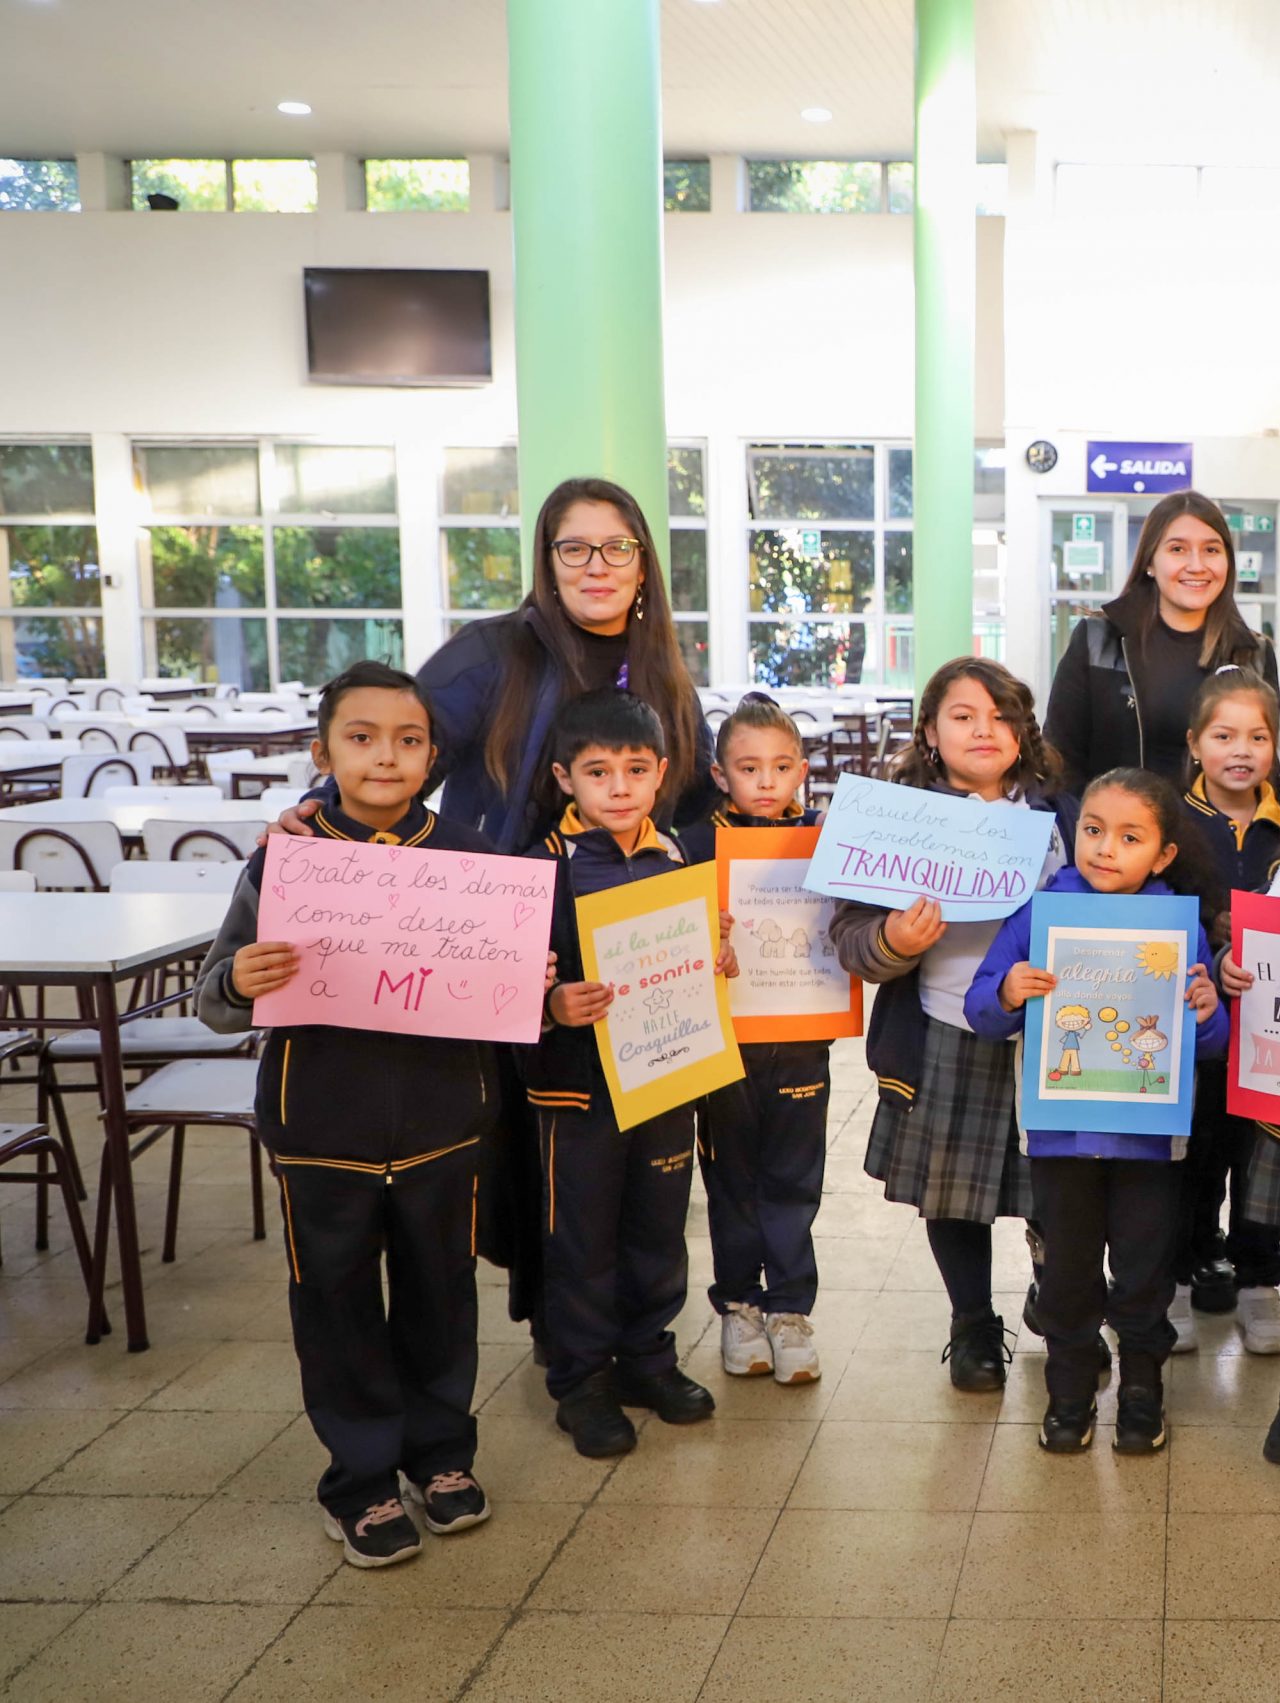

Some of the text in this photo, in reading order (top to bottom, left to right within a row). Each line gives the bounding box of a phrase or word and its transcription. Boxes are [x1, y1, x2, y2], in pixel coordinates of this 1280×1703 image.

[1120, 459, 1187, 476] SALIDA
[838, 782, 1014, 840] Resuelve los
[852, 828, 1034, 867] problemas con
[279, 838, 548, 899] Trato a los demás
[287, 904, 487, 933] como deseo
[306, 936, 523, 970] que me traten
[603, 917, 699, 960] si la vida
[639, 949, 668, 969] no
[1257, 962, 1276, 982] EL
[310, 979, 338, 998] a
[639, 959, 705, 989] sonríe
[1075, 991, 1104, 1000] donde
[642, 1009, 681, 1035] HAZLE
[618, 1017, 712, 1063] Cosquillas
[1256, 1045, 1273, 1069] LA
